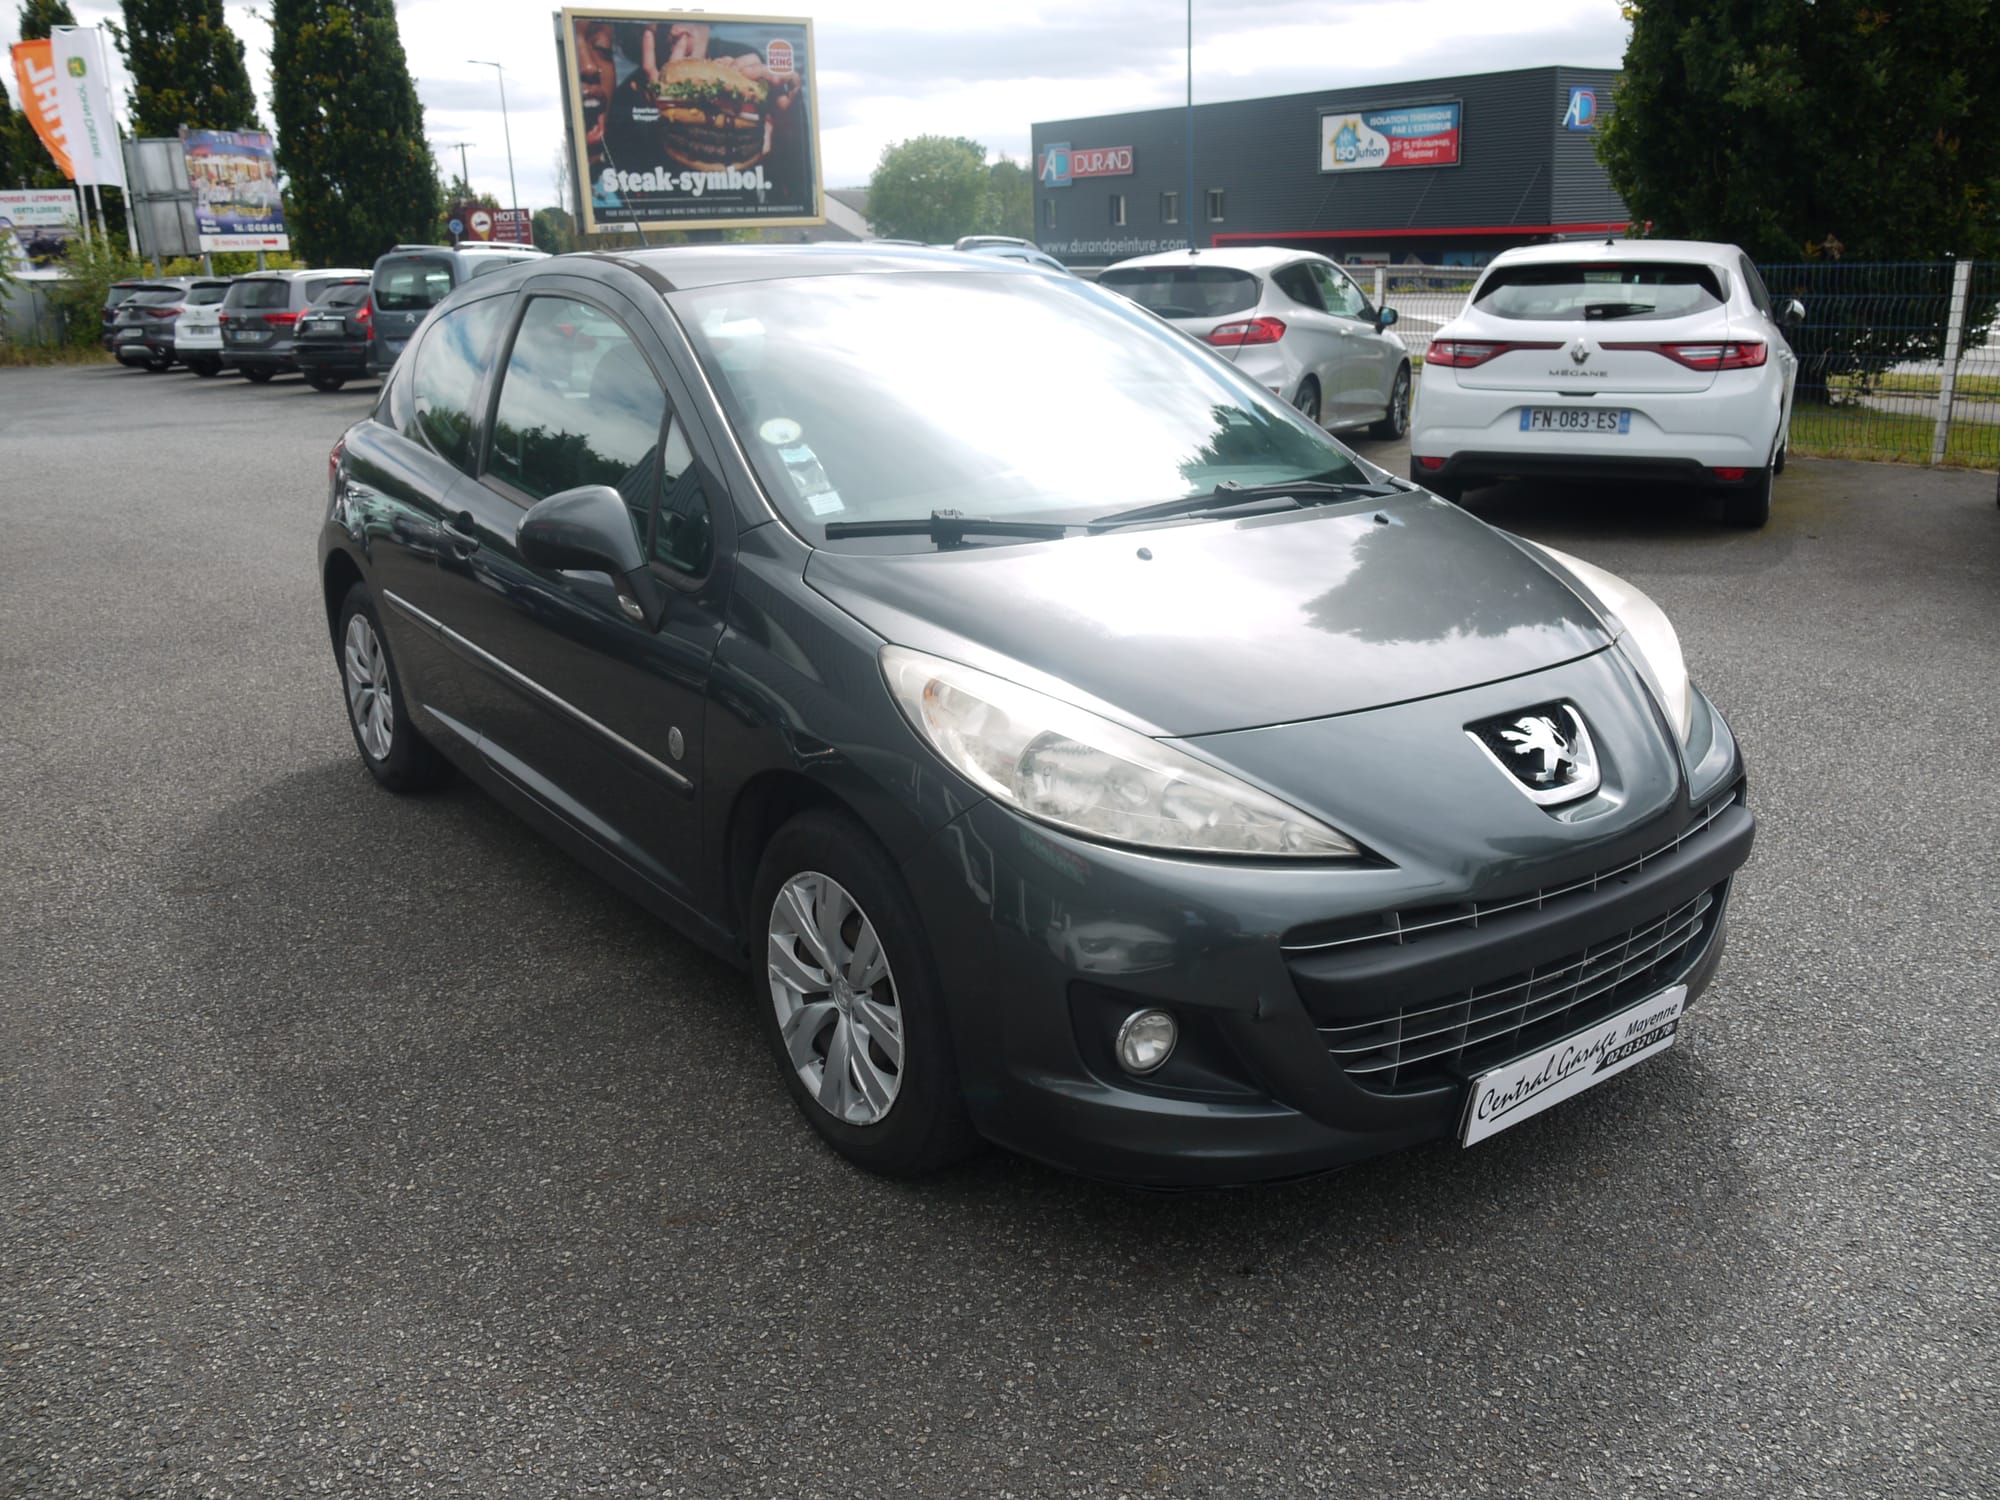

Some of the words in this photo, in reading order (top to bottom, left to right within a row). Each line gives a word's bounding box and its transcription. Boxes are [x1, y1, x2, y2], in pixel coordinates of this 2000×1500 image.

[769, 58, 792, 66] KING
[1370, 115, 1408, 127] ISOLATION
[1074, 151, 1132, 174] DURAND
[602, 165, 772, 197] Steak-symbol.
[1041, 237, 1189, 255] www.durandpeinture.com
[1532, 411, 1618, 429] FN-083-ES
[1478, 1053, 1555, 1120] Central
[1554, 1031, 1617, 1078] Garage
[1625, 1003, 1678, 1039] Mayenne
[1607, 1049, 1620, 1064] 02
